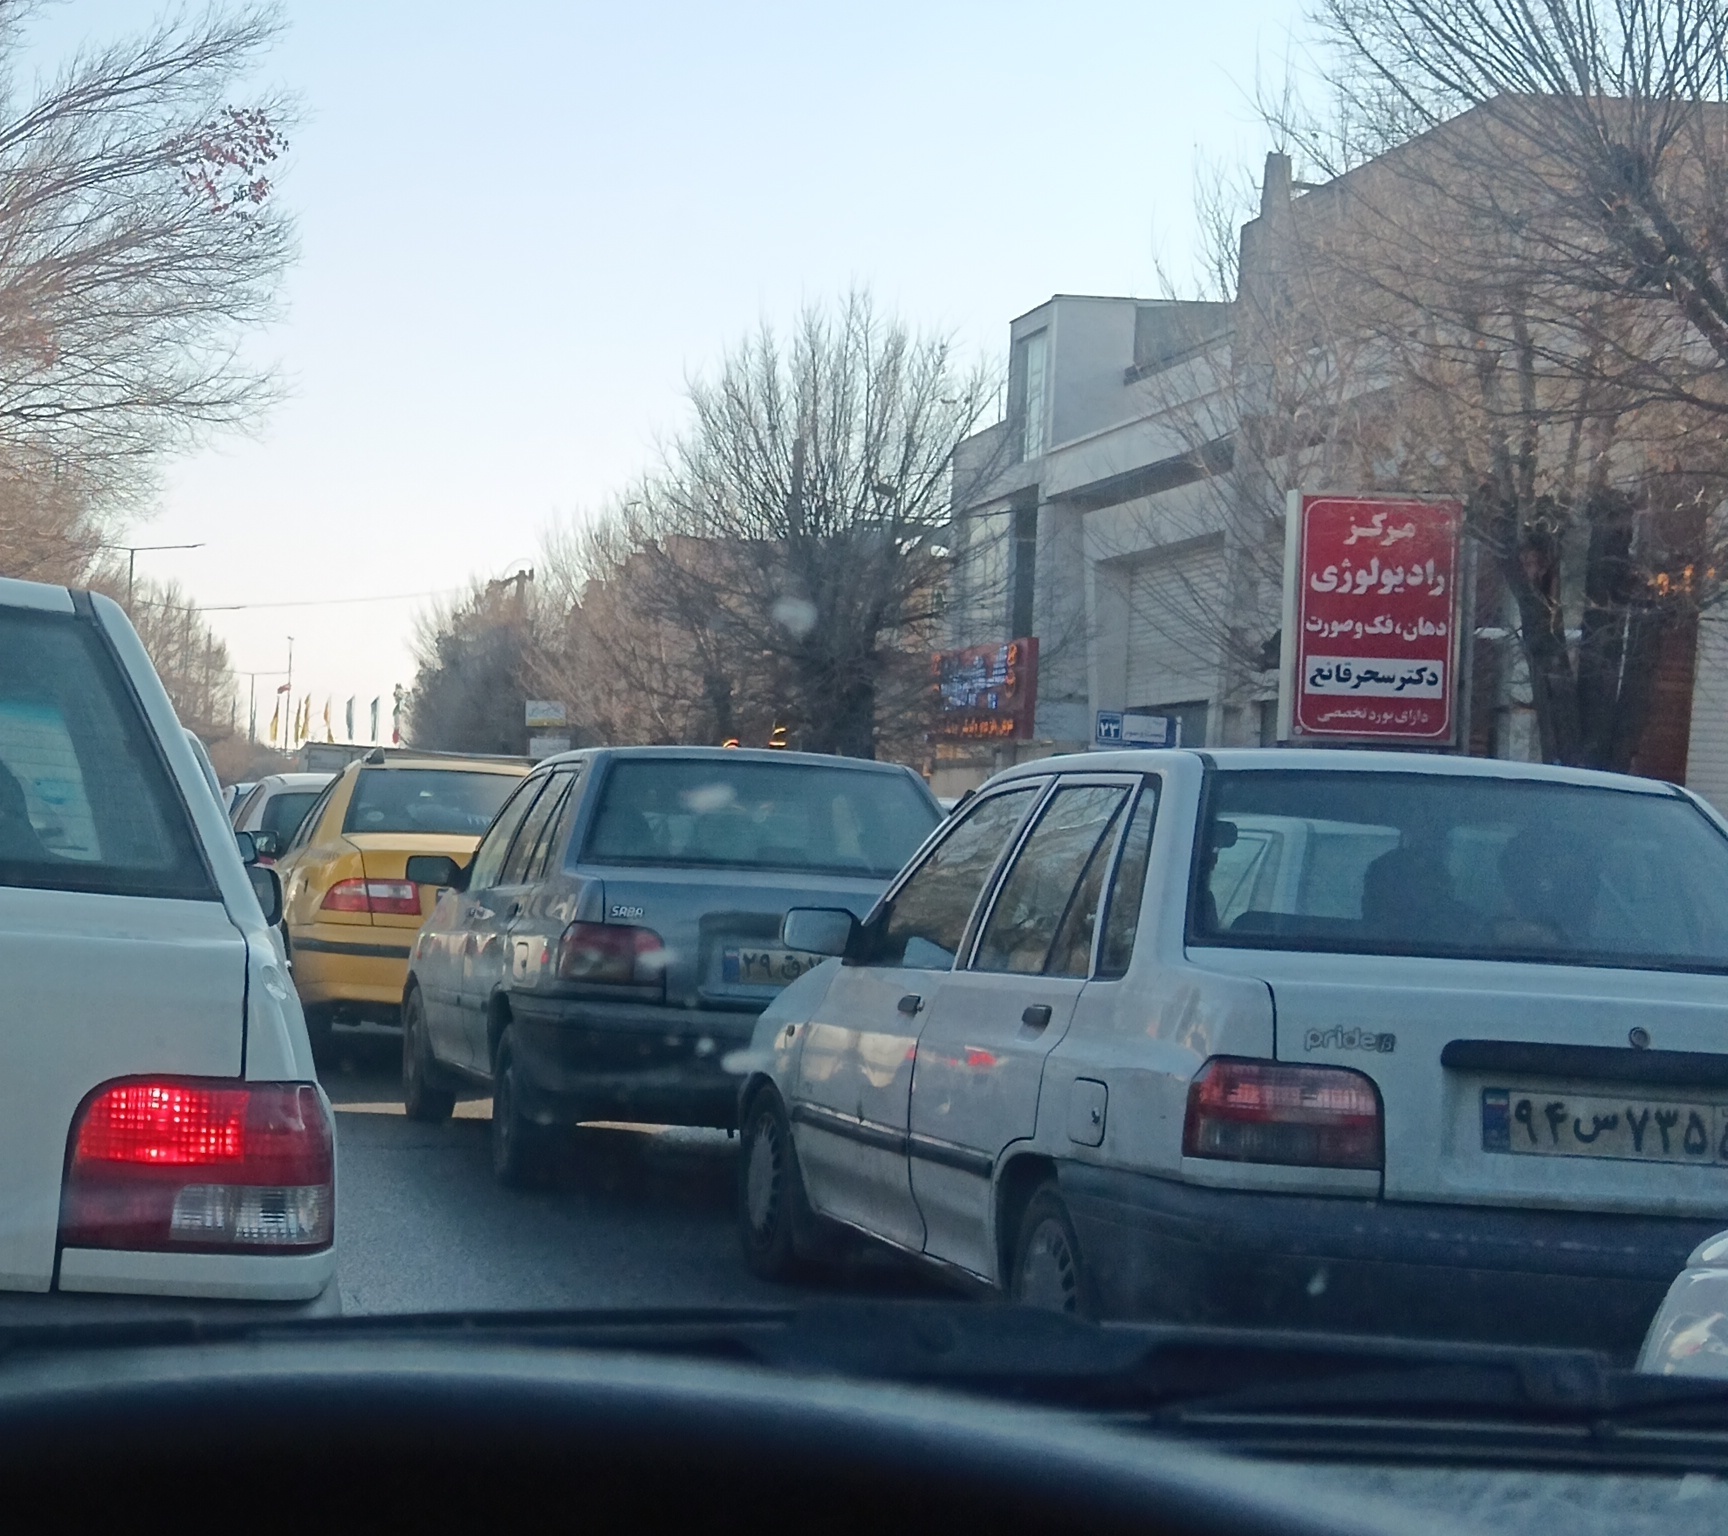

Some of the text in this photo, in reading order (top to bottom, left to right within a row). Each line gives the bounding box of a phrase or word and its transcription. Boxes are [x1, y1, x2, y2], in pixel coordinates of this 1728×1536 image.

[1343, 512, 1416, 546] مرکز
[1310, 556, 1445, 596] رادیولوژی
[1364, 614, 1393, 635] فک
[1309, 661, 1439, 691] دکتر سحر قانع
[611, 904, 644, 918] SABA
[1304, 1024, 1376, 1052] pride
